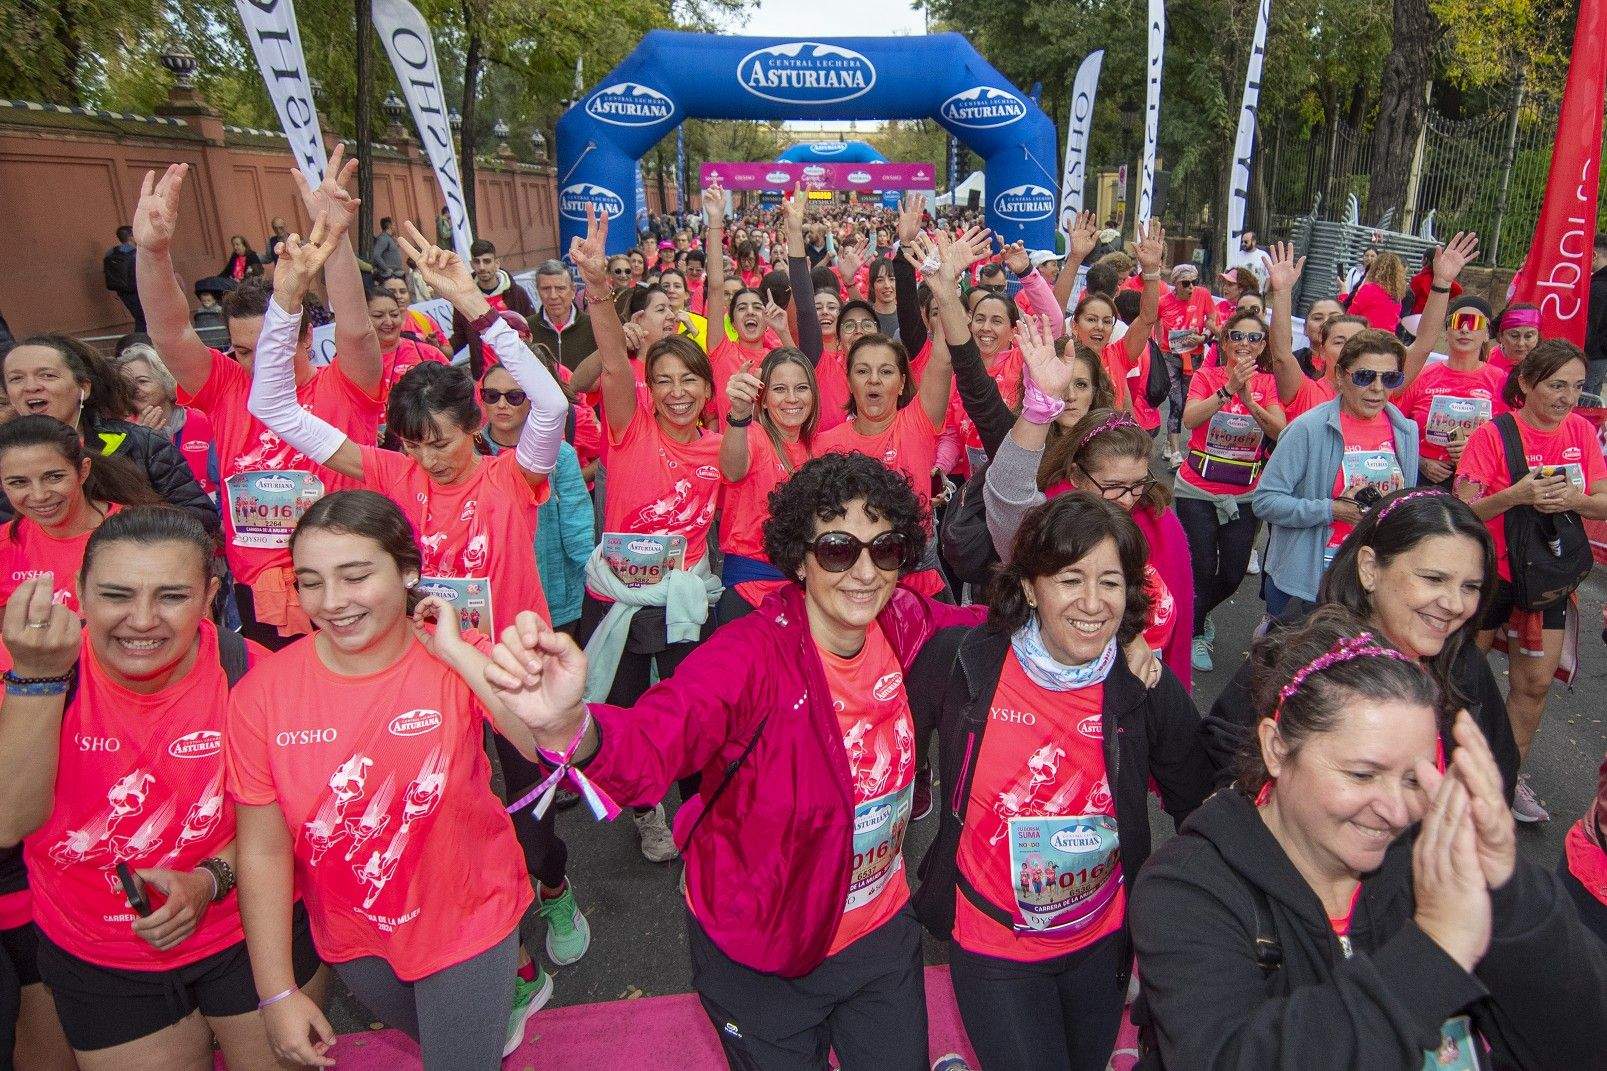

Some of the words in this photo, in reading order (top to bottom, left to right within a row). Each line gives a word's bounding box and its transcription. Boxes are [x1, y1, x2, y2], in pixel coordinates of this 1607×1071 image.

[768, 58, 813, 67] CENTRAL
[816, 60, 861, 68] LECHERA
[748, 60, 867, 88] ASTURIANA
[590, 98, 668, 117] ASTURIANA
[948, 103, 1022, 119] ASTURIANA
[1526, 454, 1543, 462] SHO
[259, 480, 294, 488] ASTURIANA
[258, 504, 293, 517] 016
[628, 564, 660, 576] 016
[991, 707, 1036, 726] YSHO
[75, 733, 121, 752] SHO
[276, 727, 337, 747] OYSHO
[174, 740, 221, 754] ASTURIAN
[1018, 831, 1041, 839] SUMA
[1054, 835, 1100, 847] ASTURIAN
[853, 840, 889, 871] 016
[857, 866, 877, 881] 6537
[1058, 863, 1105, 889] 016
[849, 883, 858, 891] DE
[858, 877, 866, 887] LA
[1034, 902, 1062, 912] CARRERA
[1062, 899, 1071, 907] DE
[1071, 895, 1079, 903] LA
[387, 917, 397, 927] LA
